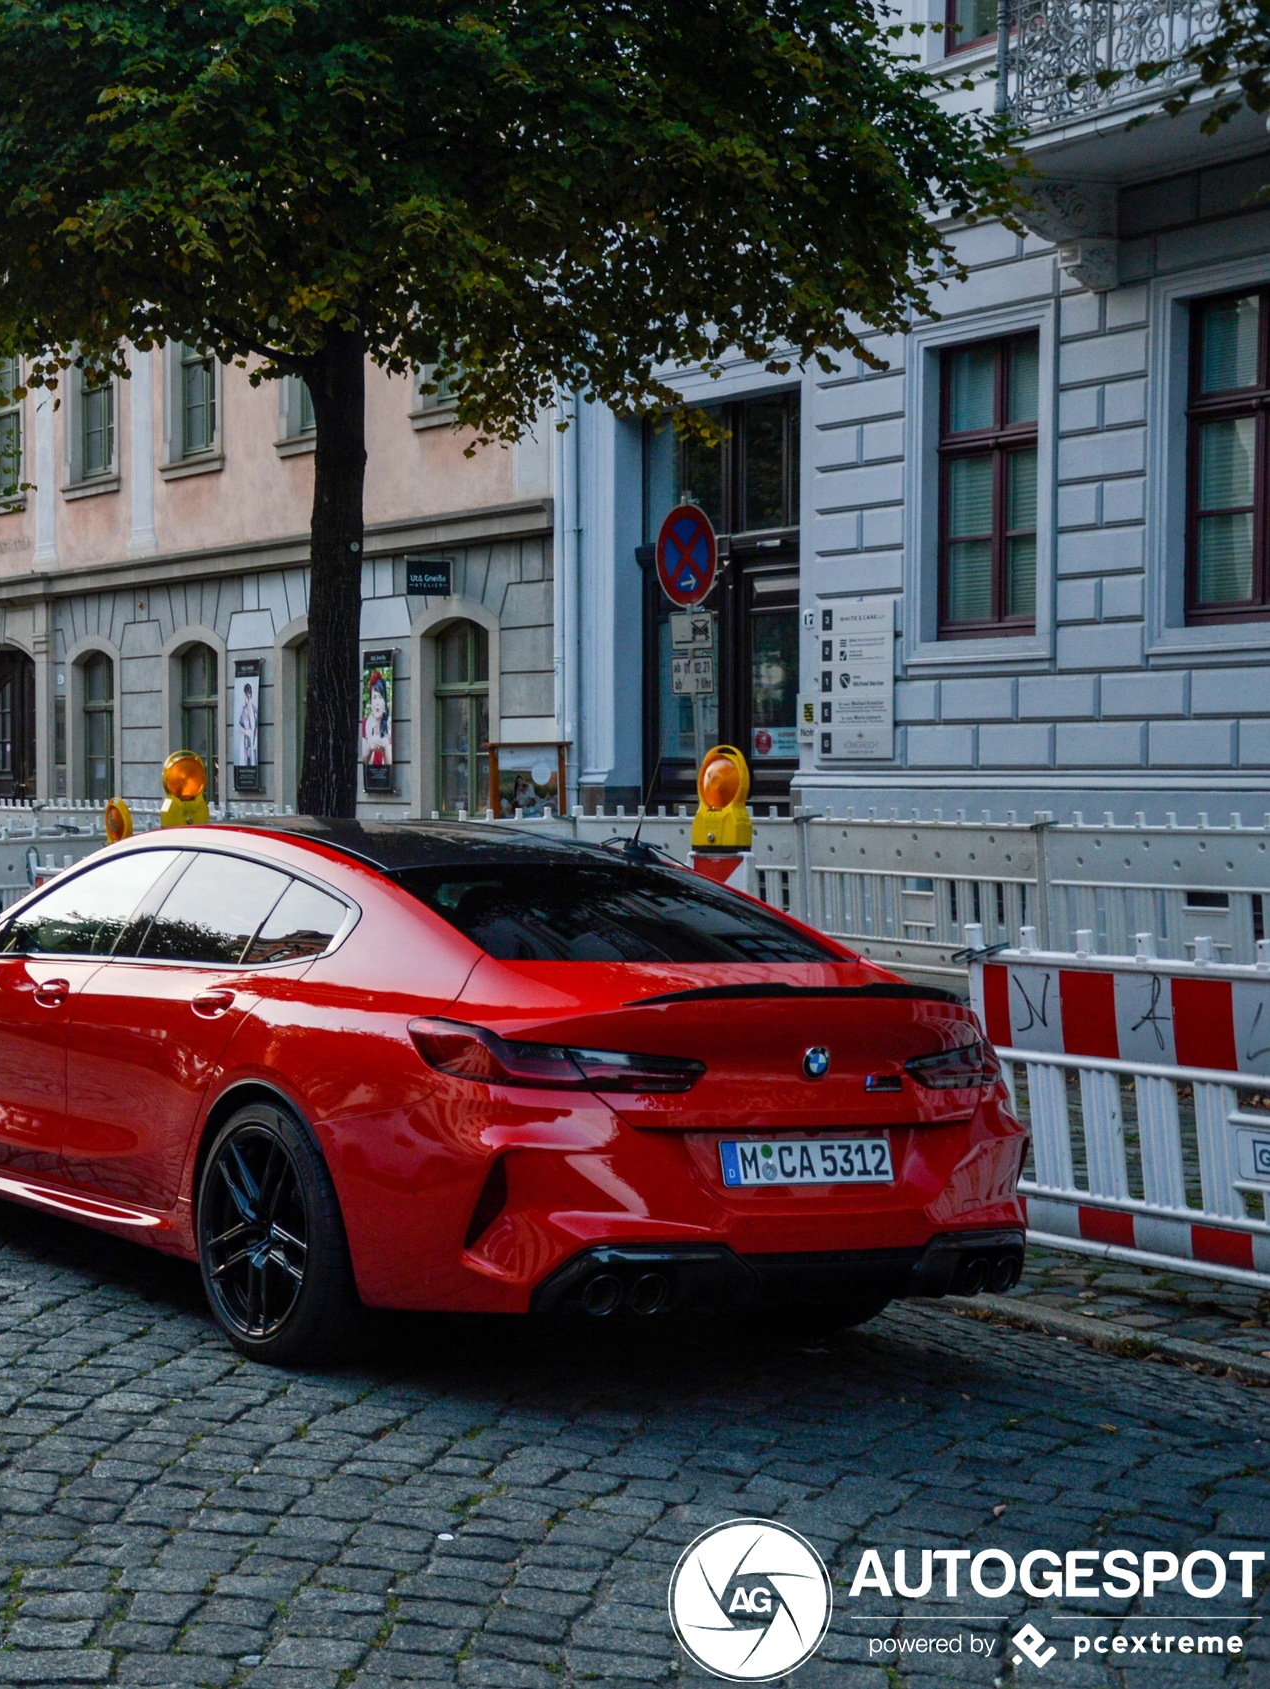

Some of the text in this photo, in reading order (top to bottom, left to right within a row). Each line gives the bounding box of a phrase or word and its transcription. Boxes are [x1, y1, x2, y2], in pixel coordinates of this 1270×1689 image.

[824, 616, 830, 624] 3
[739, 1143, 890, 1180] M CA 5312
[728, 1168, 736, 1179] D
